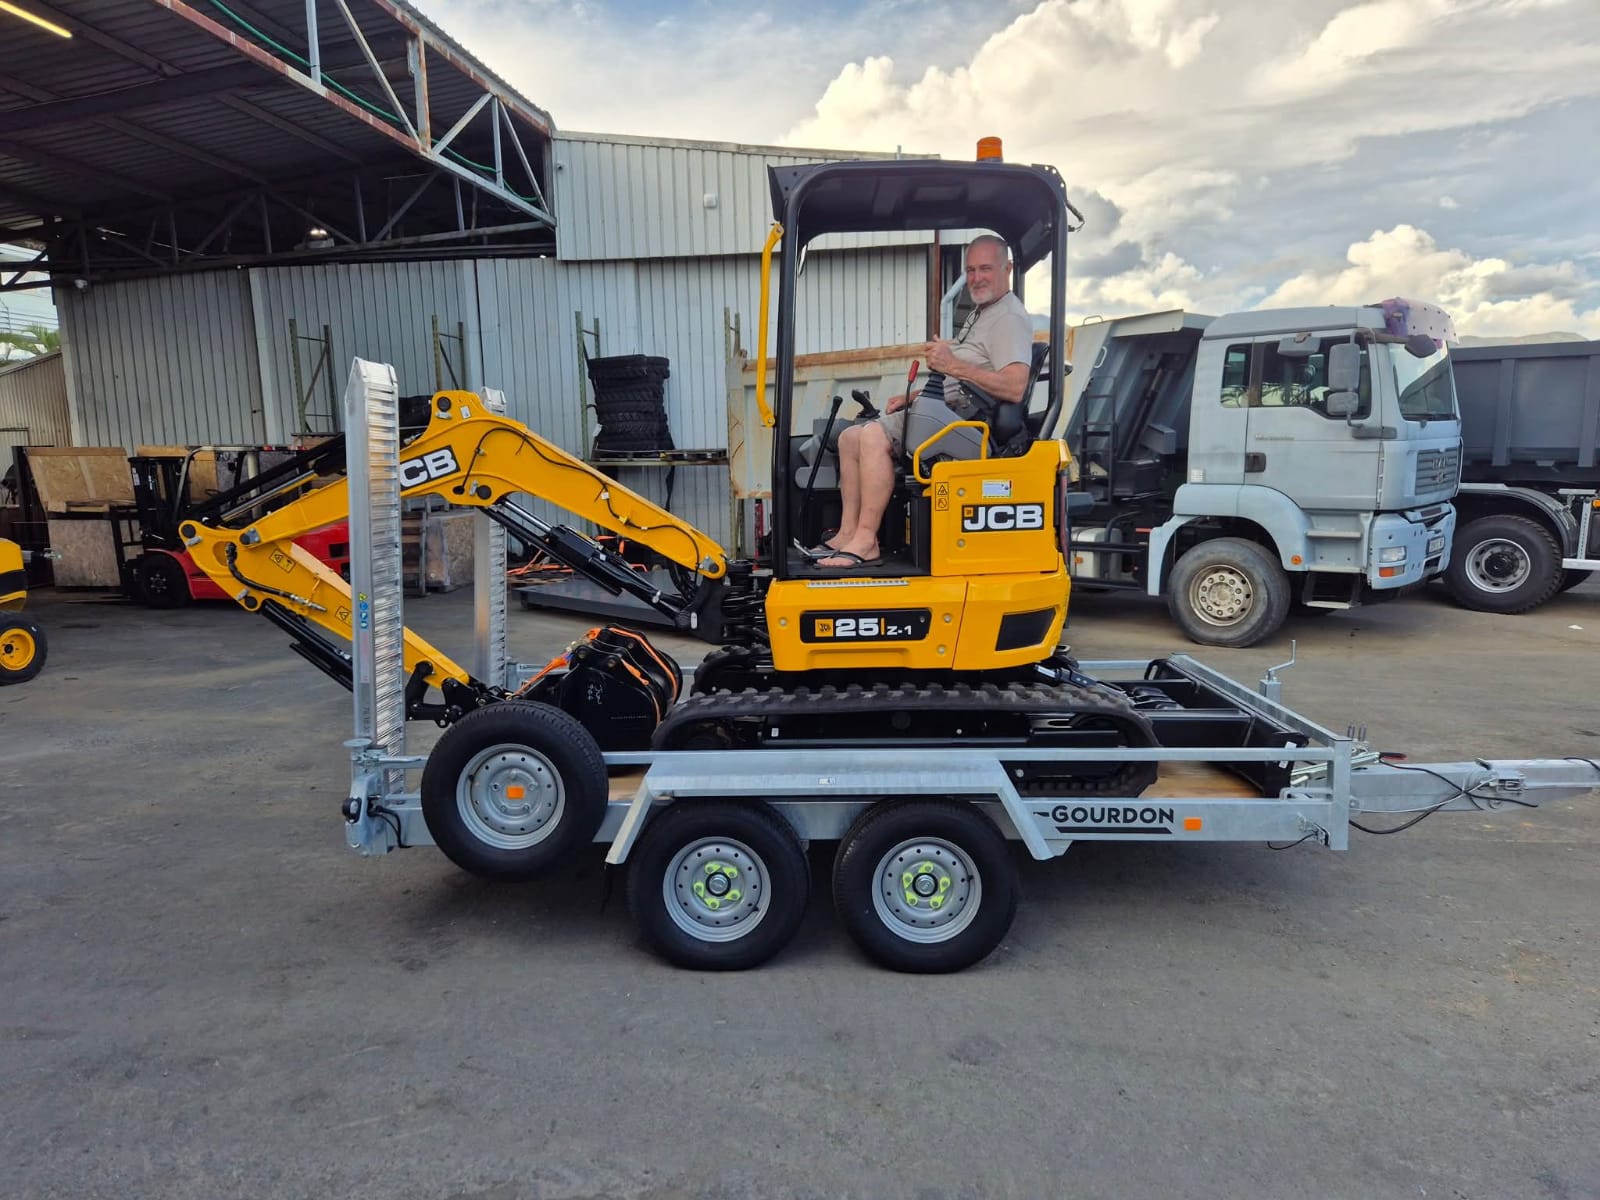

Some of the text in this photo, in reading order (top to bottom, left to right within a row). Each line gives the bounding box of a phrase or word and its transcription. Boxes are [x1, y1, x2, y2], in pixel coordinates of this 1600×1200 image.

[400, 449, 456, 487] CB
[963, 505, 1043, 530] JCB
[1051, 805, 1174, 824] GOURDON
